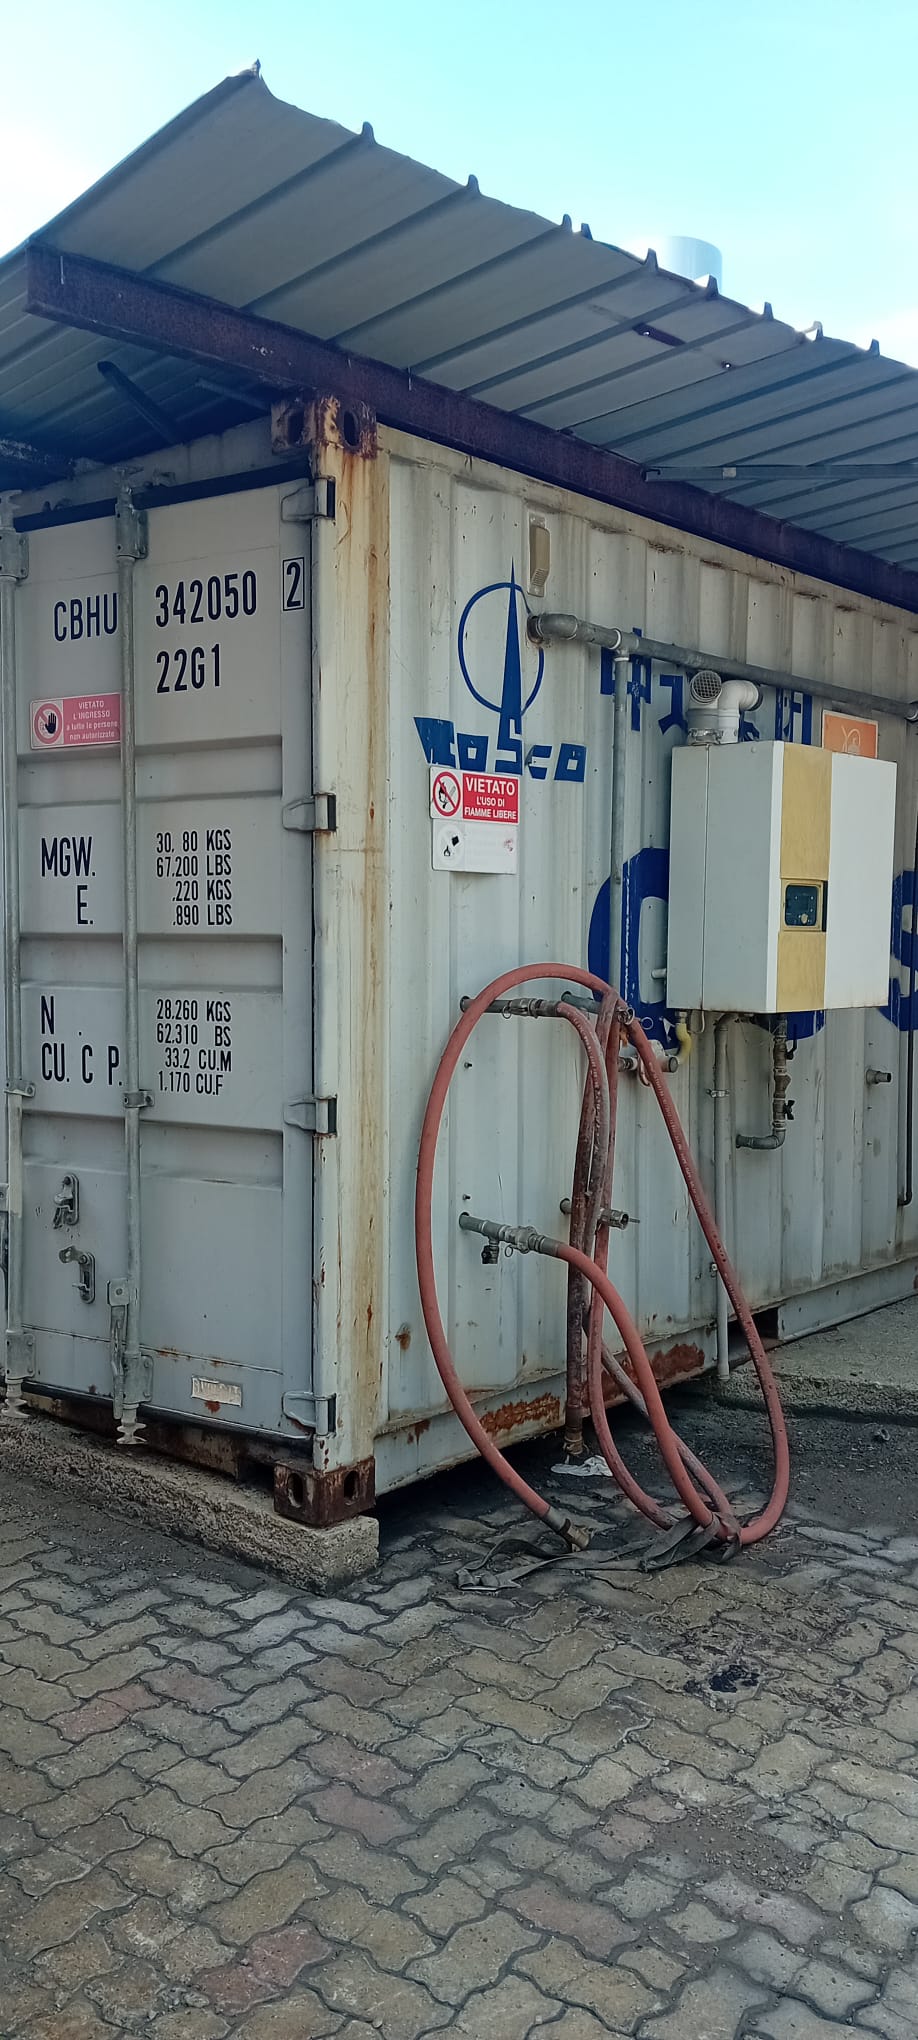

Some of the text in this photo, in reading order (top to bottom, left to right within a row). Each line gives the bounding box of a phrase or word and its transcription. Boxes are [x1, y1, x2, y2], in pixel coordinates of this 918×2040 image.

[54, 561, 302, 641] CBHU 342050 2
[156, 643, 221, 693] 22G1
[78, 700, 104, 709] VIETATO
[69, 733, 81, 742] non
[465, 776, 516, 796] VIETATO
[476, 796, 505, 807] L'USO DI
[464, 806, 517, 820] FIAMME LIBERE
[207, 829, 232, 851] KGS
[41, 836, 96, 877] MGW.
[207, 854, 232, 876] LBS
[207, 879, 232, 901] KGS
[207, 903, 233, 925] LBS
[206, 1000, 231, 1022] KGS
[215, 1025, 232, 1047] BS
[41, 1042, 70, 1082] CU.
[165, 1047, 232, 1072] 33.2 CU.M
[196, 1072, 224, 1095] CU.F
